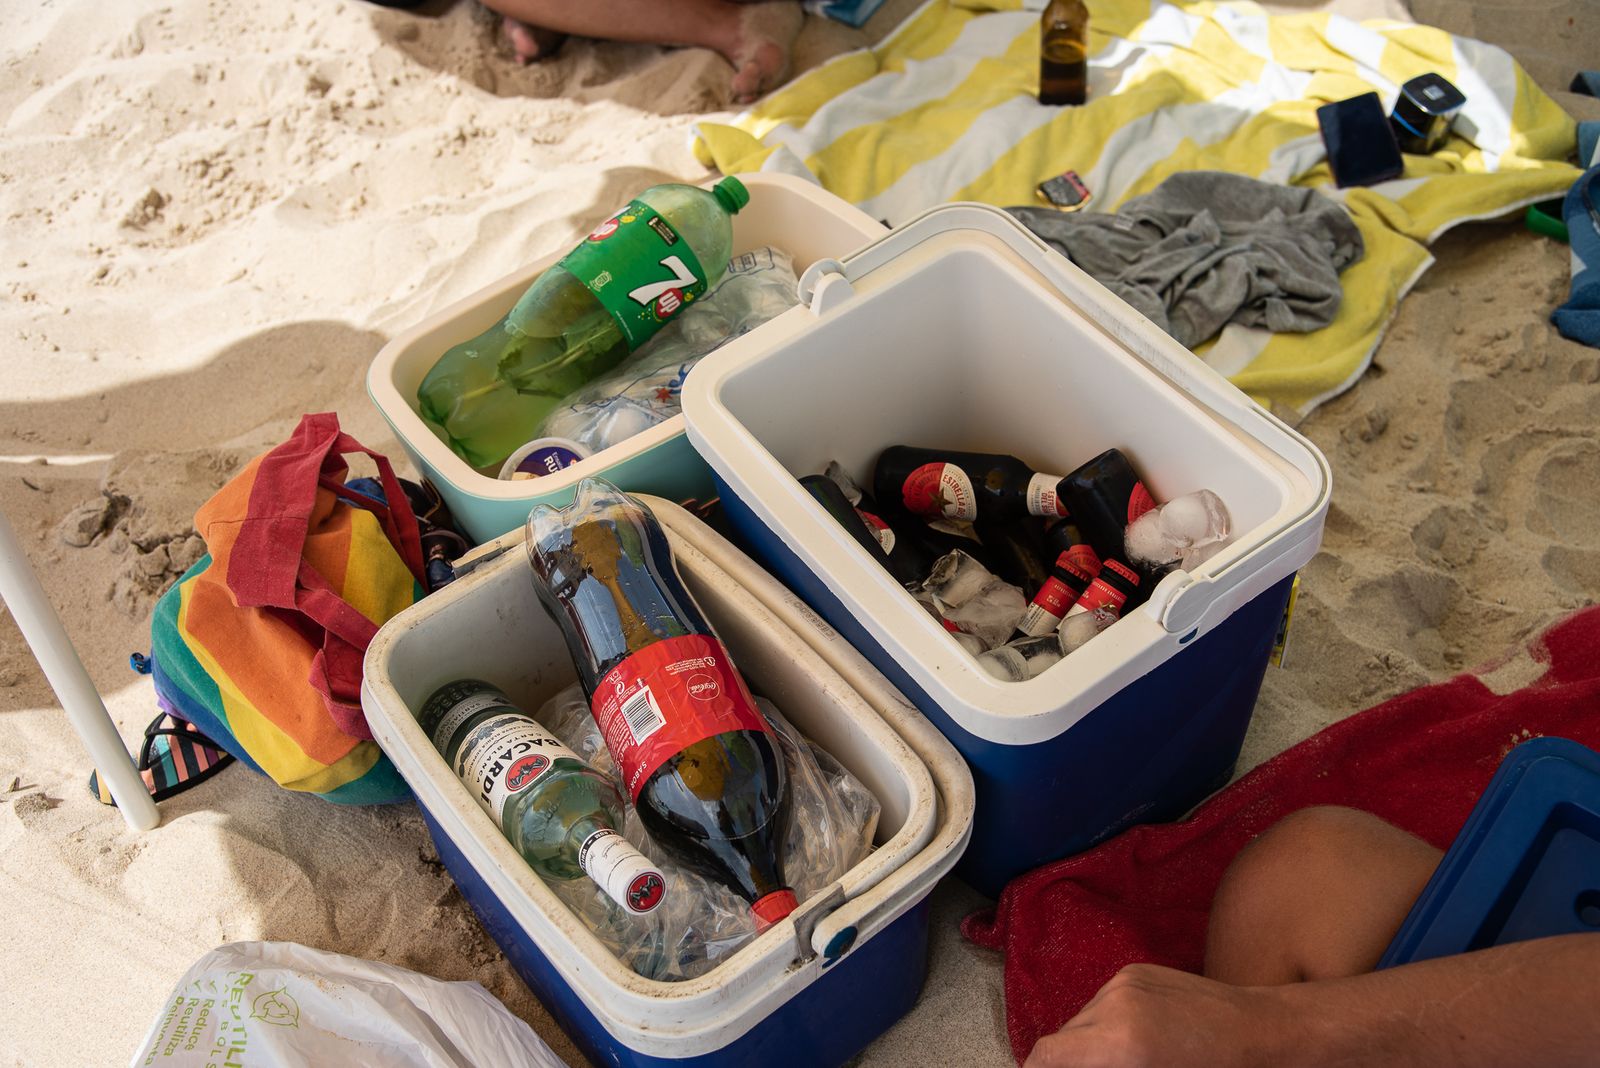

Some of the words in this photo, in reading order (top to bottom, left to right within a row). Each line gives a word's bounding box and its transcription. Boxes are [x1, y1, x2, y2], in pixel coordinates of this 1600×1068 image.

[628, 255, 698, 306] 7
[943, 475, 965, 507] ESTRELLA
[506, 732, 543, 745] CARTA
[476, 745, 505, 783] BLANCA
[630, 760, 648, 789] SABOR
[163, 998, 200, 1056] Reutiliza
[184, 998, 215, 1051] Reduce
